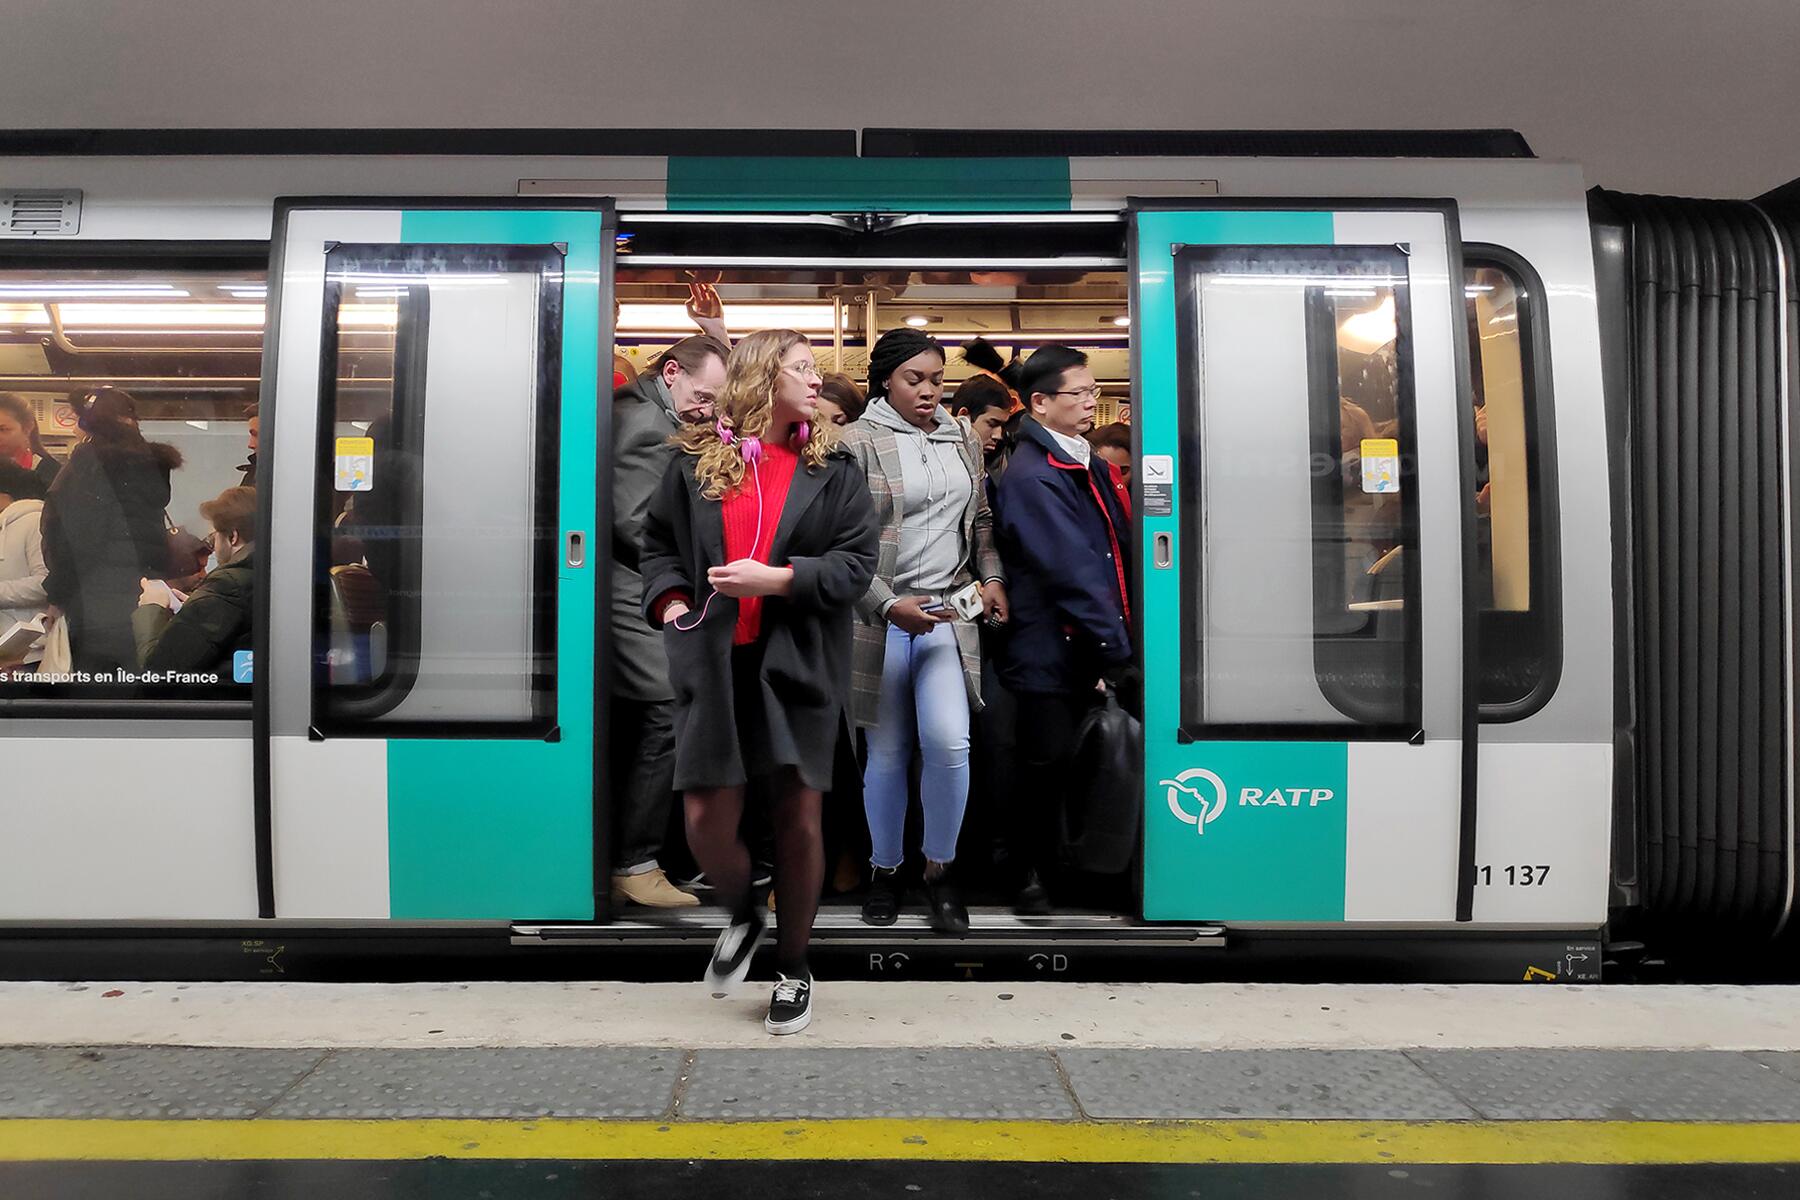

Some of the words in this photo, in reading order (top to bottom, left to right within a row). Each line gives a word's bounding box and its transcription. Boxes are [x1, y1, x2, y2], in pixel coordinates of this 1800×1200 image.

[12, 670, 91, 685] transports
[94, 672, 113, 682] en
[116, 667, 218, 683] Île-de-France
[1239, 788, 1334, 806] RATP
[1504, 865, 1550, 886] 137
[870, 954, 884, 970] R
[1053, 954, 1068, 971] D
